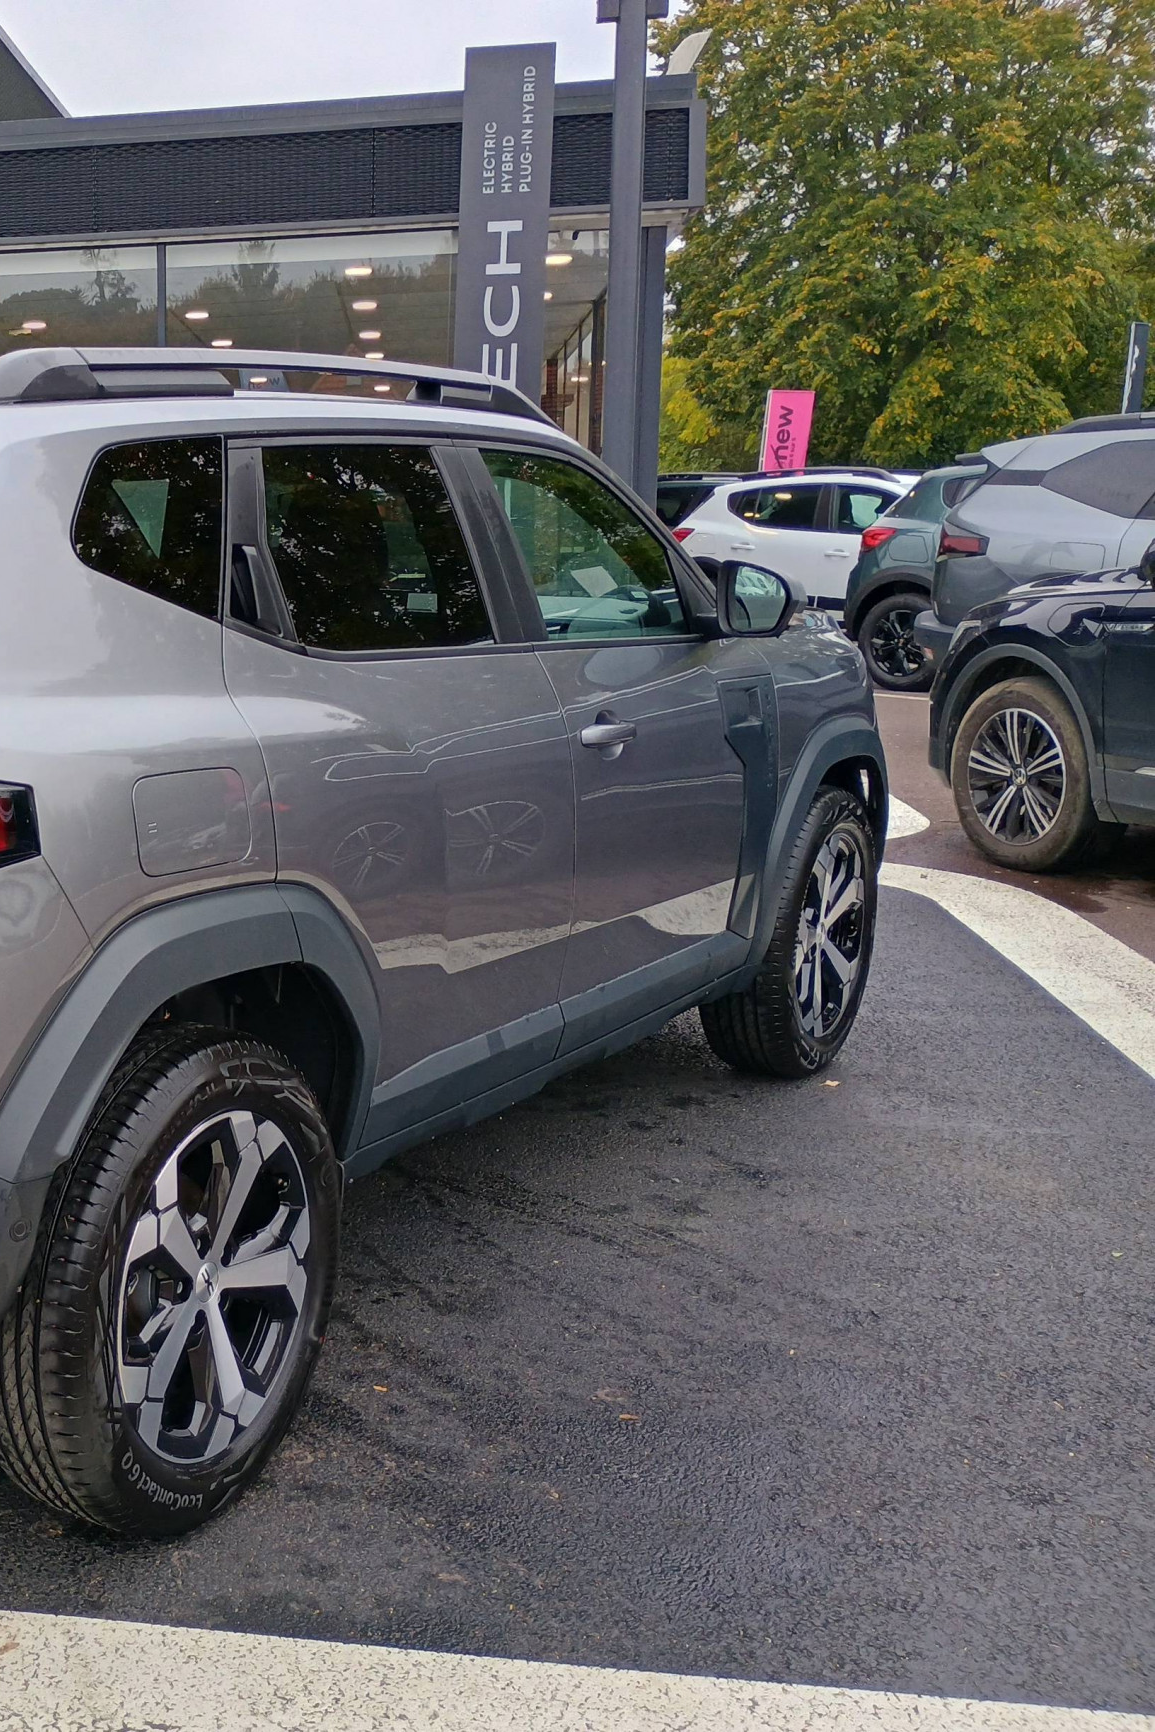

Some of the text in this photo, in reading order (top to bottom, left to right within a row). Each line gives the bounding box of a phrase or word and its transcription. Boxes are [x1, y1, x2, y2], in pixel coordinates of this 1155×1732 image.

[482, 121, 497, 194] ELECTRIC
[519, 65, 536, 193] PLUG-IN HYBRID
[501, 135, 515, 193] HYBRID
[127, 1464, 141, 1482] 6
[136, 1471, 204, 1511] EcoContact
